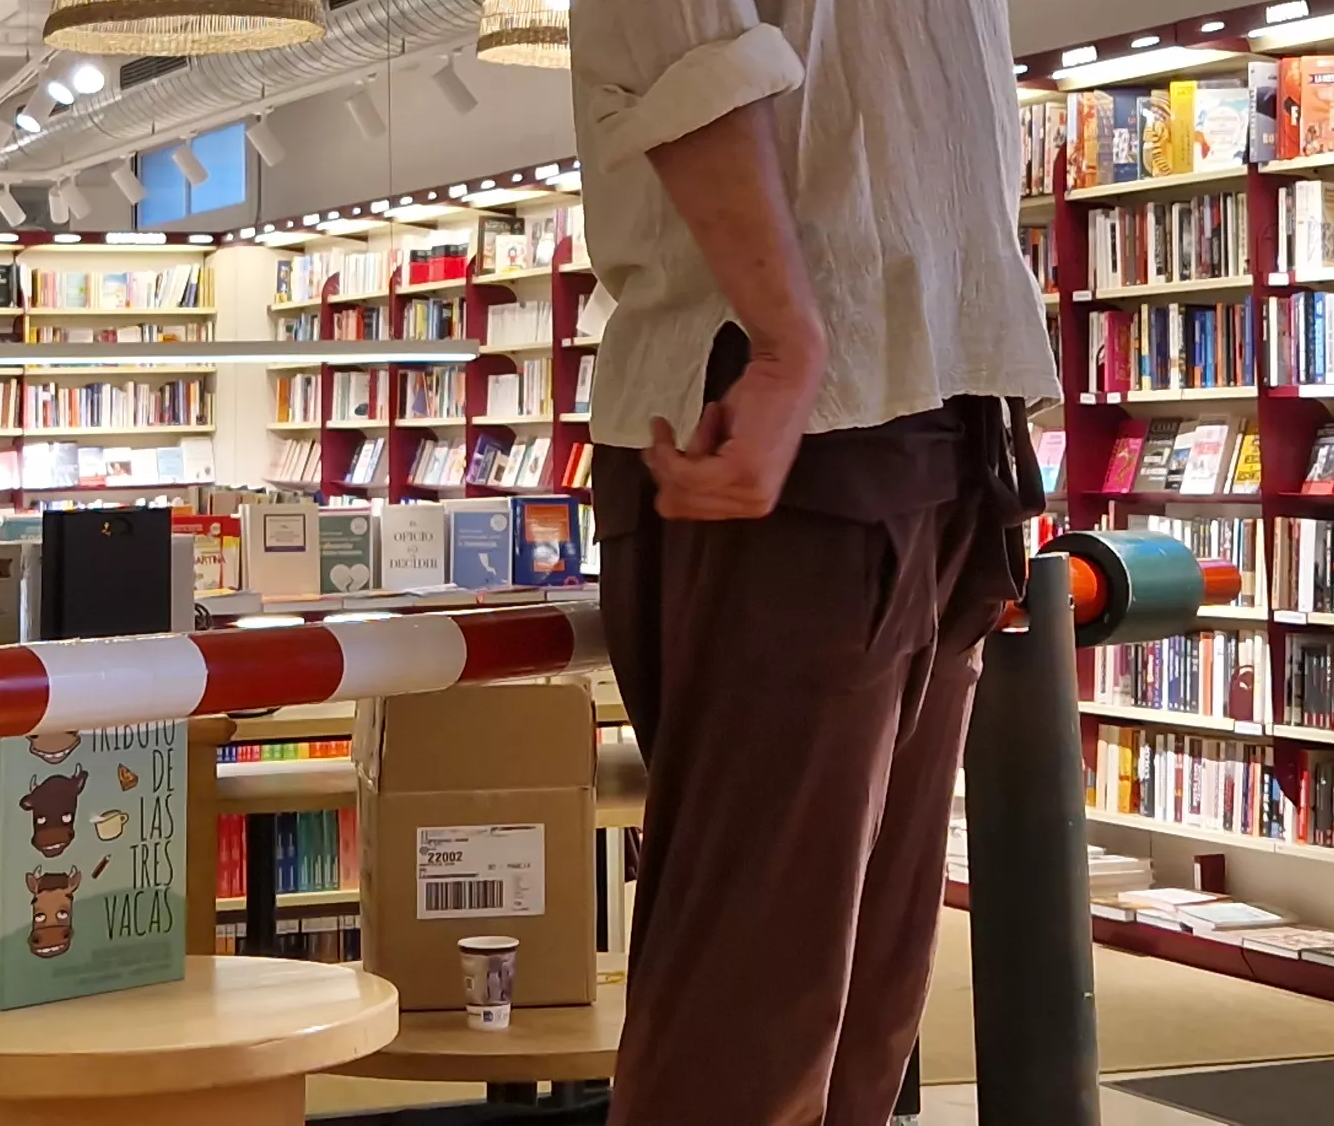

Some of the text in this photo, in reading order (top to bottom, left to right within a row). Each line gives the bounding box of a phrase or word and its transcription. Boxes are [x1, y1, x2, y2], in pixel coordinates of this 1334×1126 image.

[194, 554, 227, 565] ARTINA
[152, 749, 175, 793] DE
[139, 794, 174, 841] LAS
[129, 841, 174, 890] TRES
[427, 851, 463, 863] 22002
[104, 888, 174, 940] VACAS
